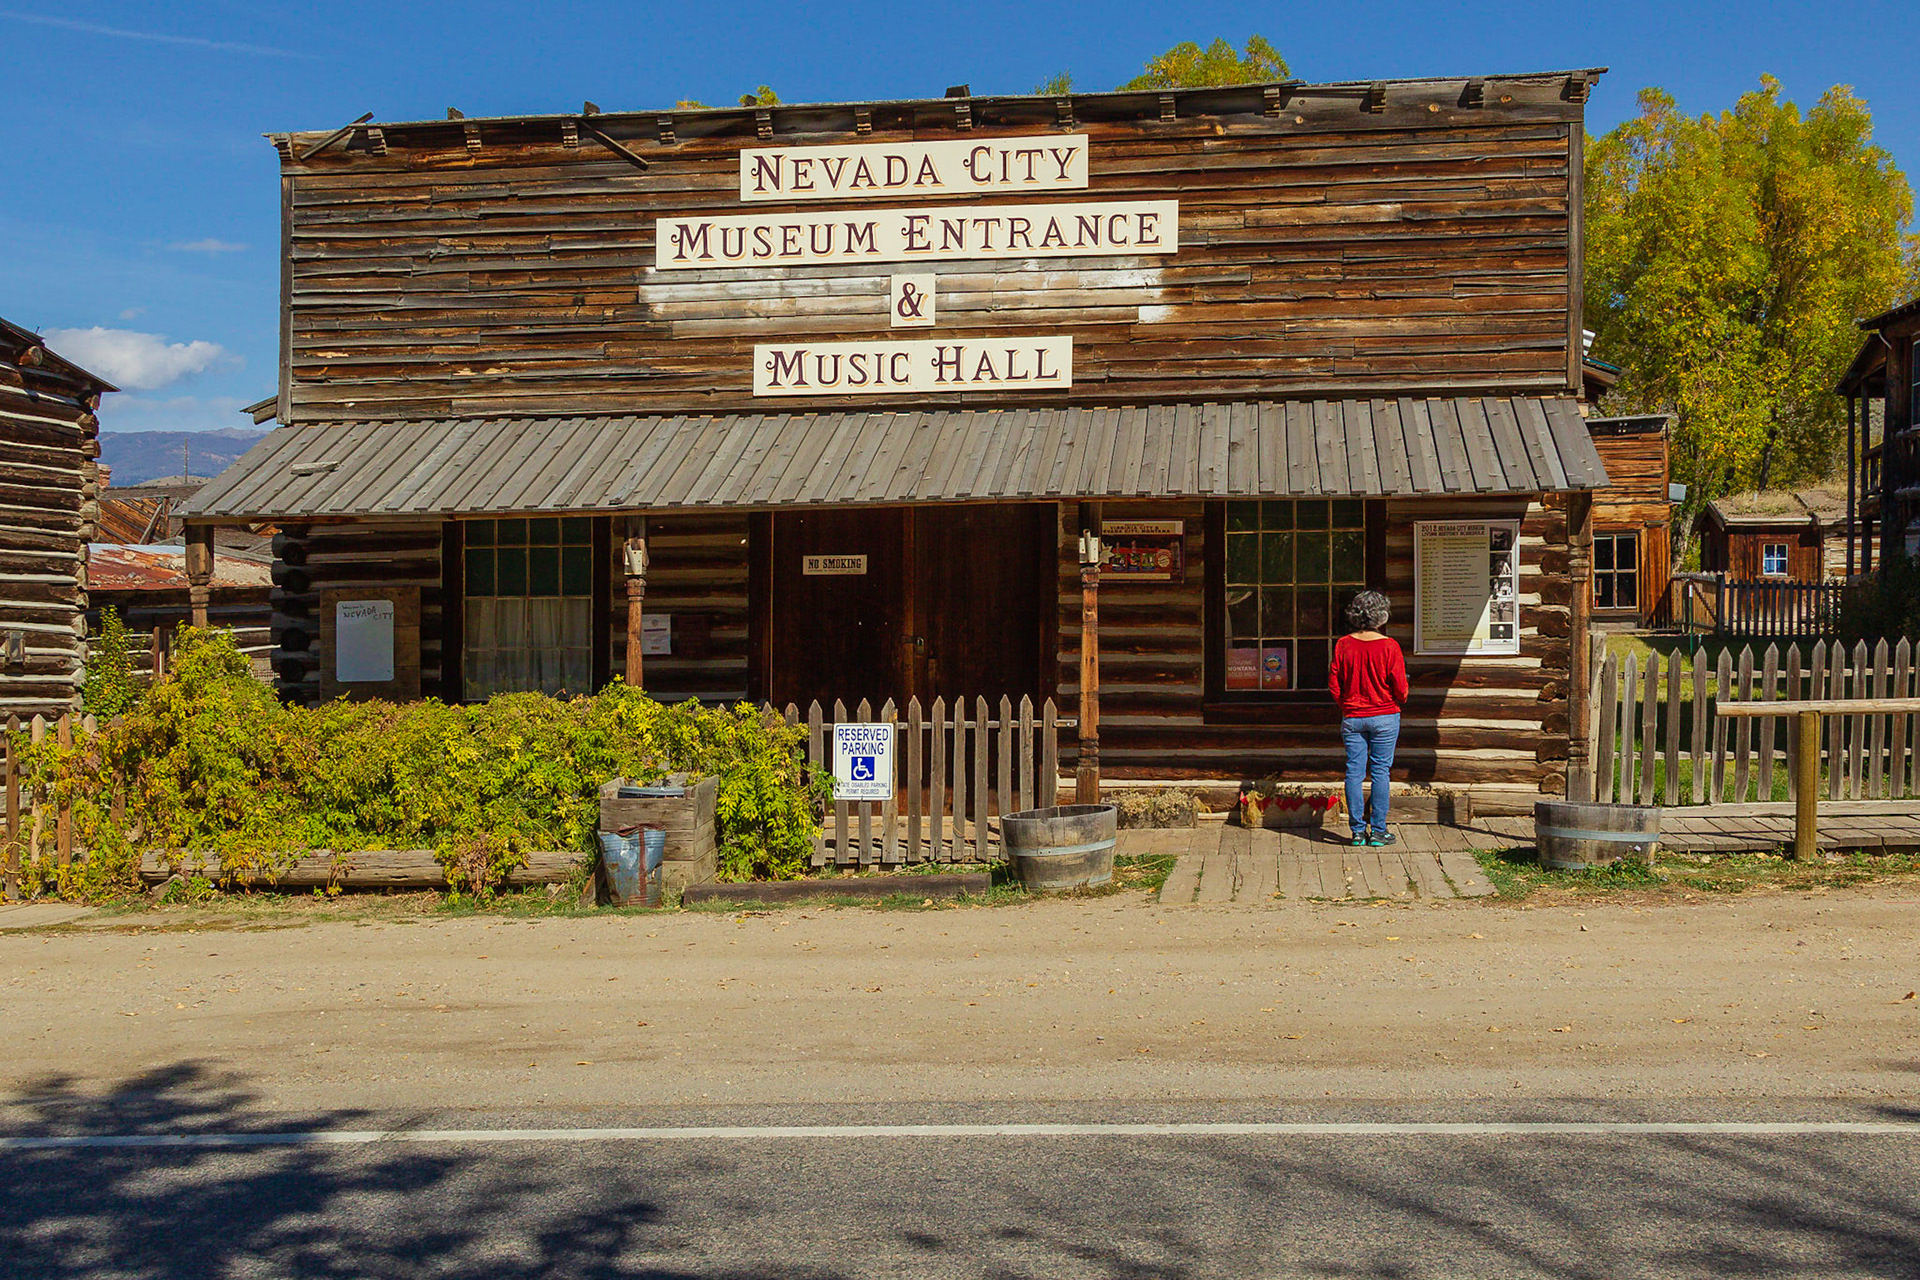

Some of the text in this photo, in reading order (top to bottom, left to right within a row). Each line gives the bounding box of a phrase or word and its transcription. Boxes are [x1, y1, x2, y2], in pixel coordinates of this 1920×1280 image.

[751, 146, 1078, 191] NEVADA CITY
[671, 212, 1161, 260] MUSEUM ENTRANCE
[898, 282, 928, 320] &
[766, 346, 1060, 387] MUSIC HALL
[808, 559, 862, 569] NO SMOKING
[838, 728, 889, 741] RESERVED
[842, 742, 885, 755] PARKING
